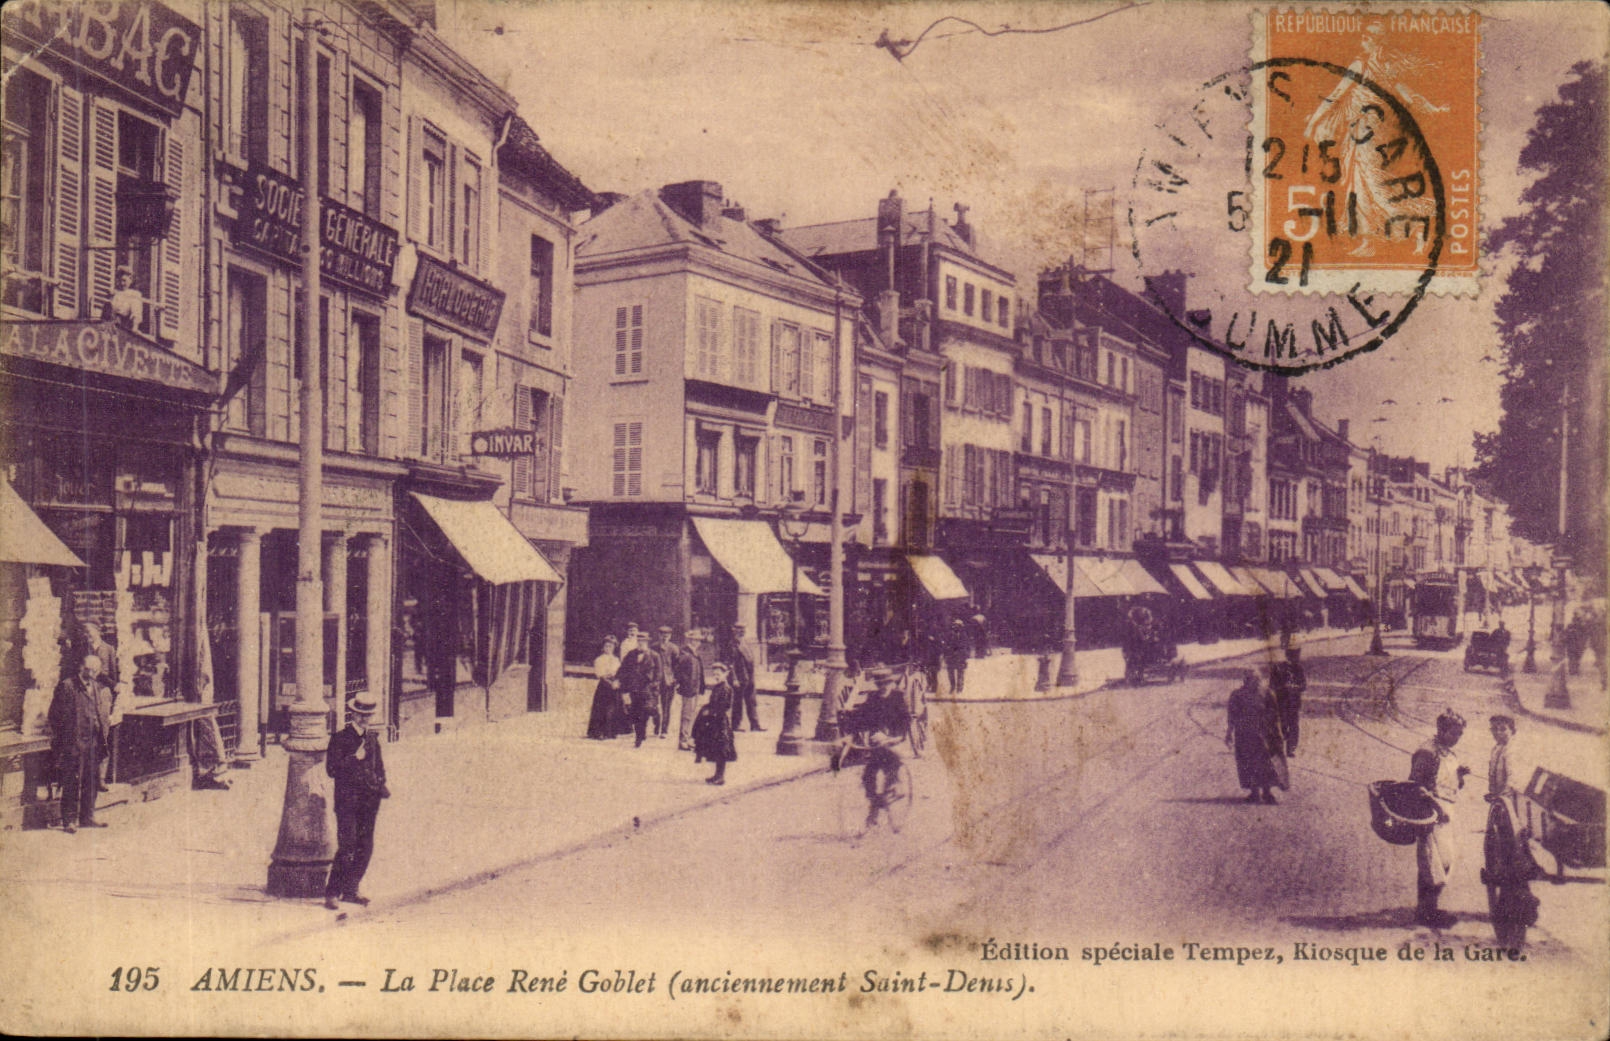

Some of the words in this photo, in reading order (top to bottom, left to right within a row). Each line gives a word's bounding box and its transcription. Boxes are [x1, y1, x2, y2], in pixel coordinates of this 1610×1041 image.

[1390, 15, 1472, 36] FRANÇAISE
[1350, 104, 1430, 243] GARE
[255, 174, 324, 227] SOCIÉ
[326, 207, 396, 267] GÉNÉRALE
[1450, 168, 1471, 255] POSTES
[420, 262, 498, 331] HORLOGERIE
[1187, 282, 1391, 359] OMME
[77, 327, 193, 382] CIVETTE
[489, 434, 533, 452] INVAR
